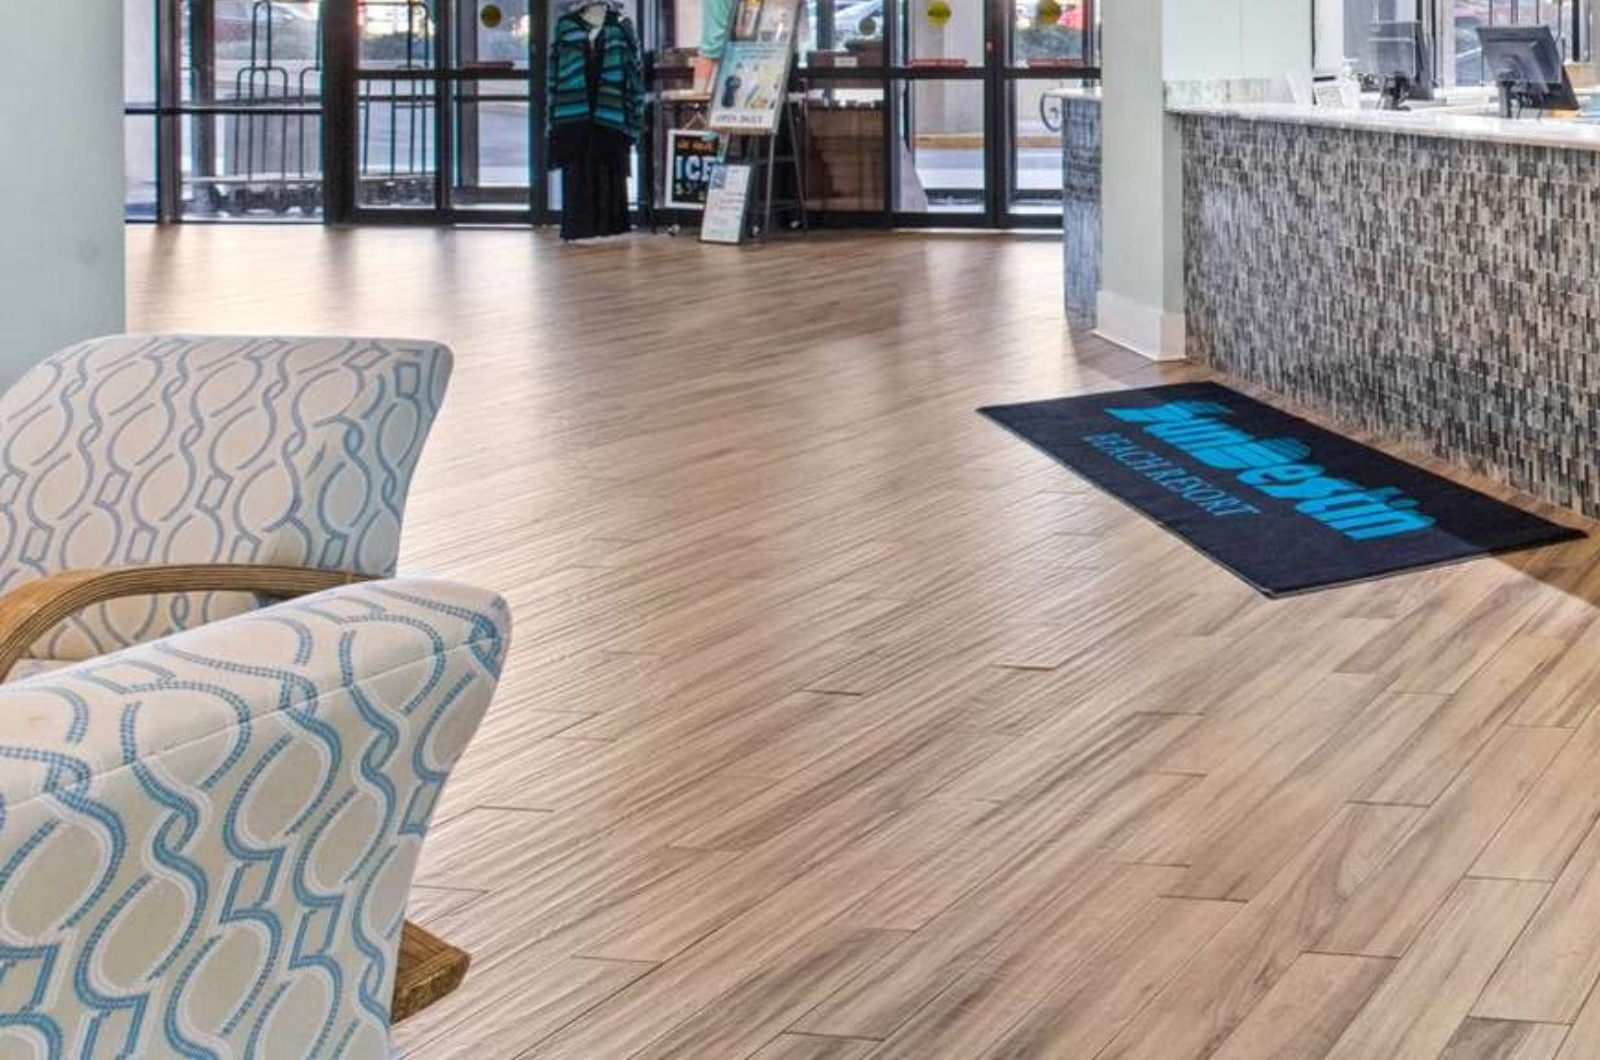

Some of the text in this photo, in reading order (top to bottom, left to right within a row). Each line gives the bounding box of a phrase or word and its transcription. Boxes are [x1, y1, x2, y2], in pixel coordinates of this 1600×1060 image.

[1083, 432, 1262, 517] BEACH RESORT
[1103, 400, 1436, 541] SunDestin
